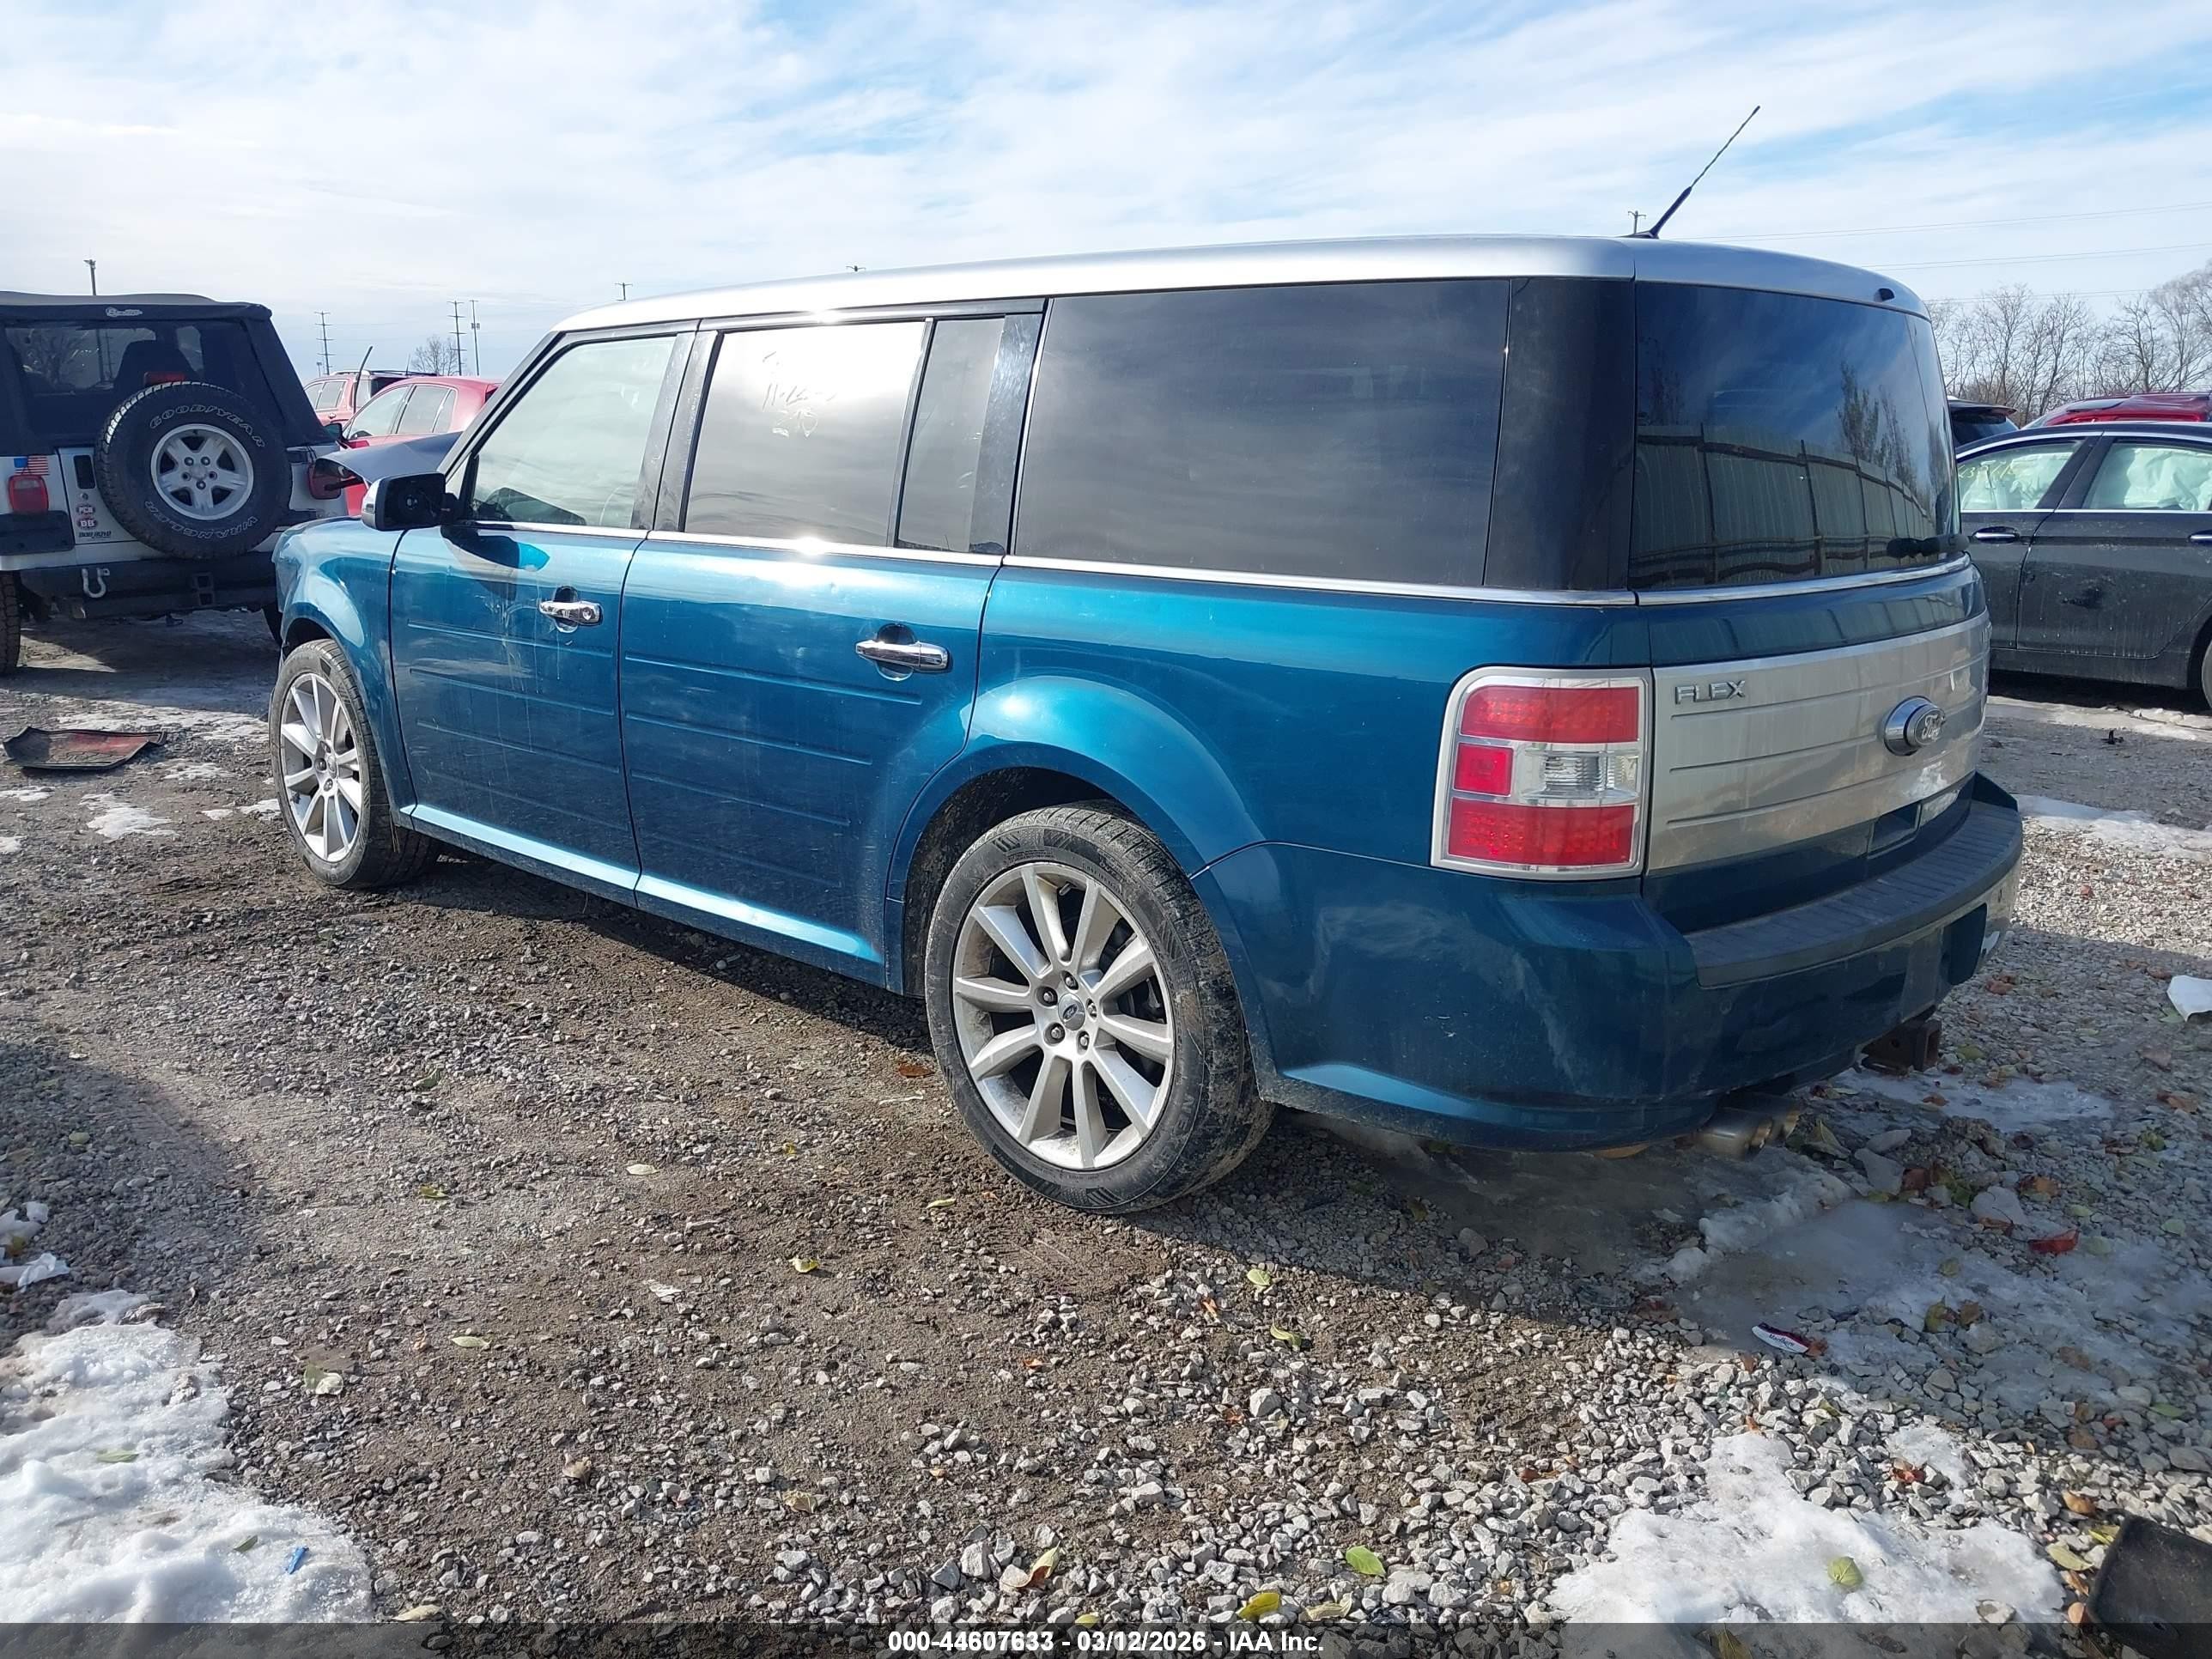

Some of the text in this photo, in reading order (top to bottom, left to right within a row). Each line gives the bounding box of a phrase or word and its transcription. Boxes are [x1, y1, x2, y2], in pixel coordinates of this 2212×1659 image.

[144, 501, 258, 539] WRANGLER
[1674, 680, 1746, 705] FLEX
[1920, 712, 1942, 743] Ford
